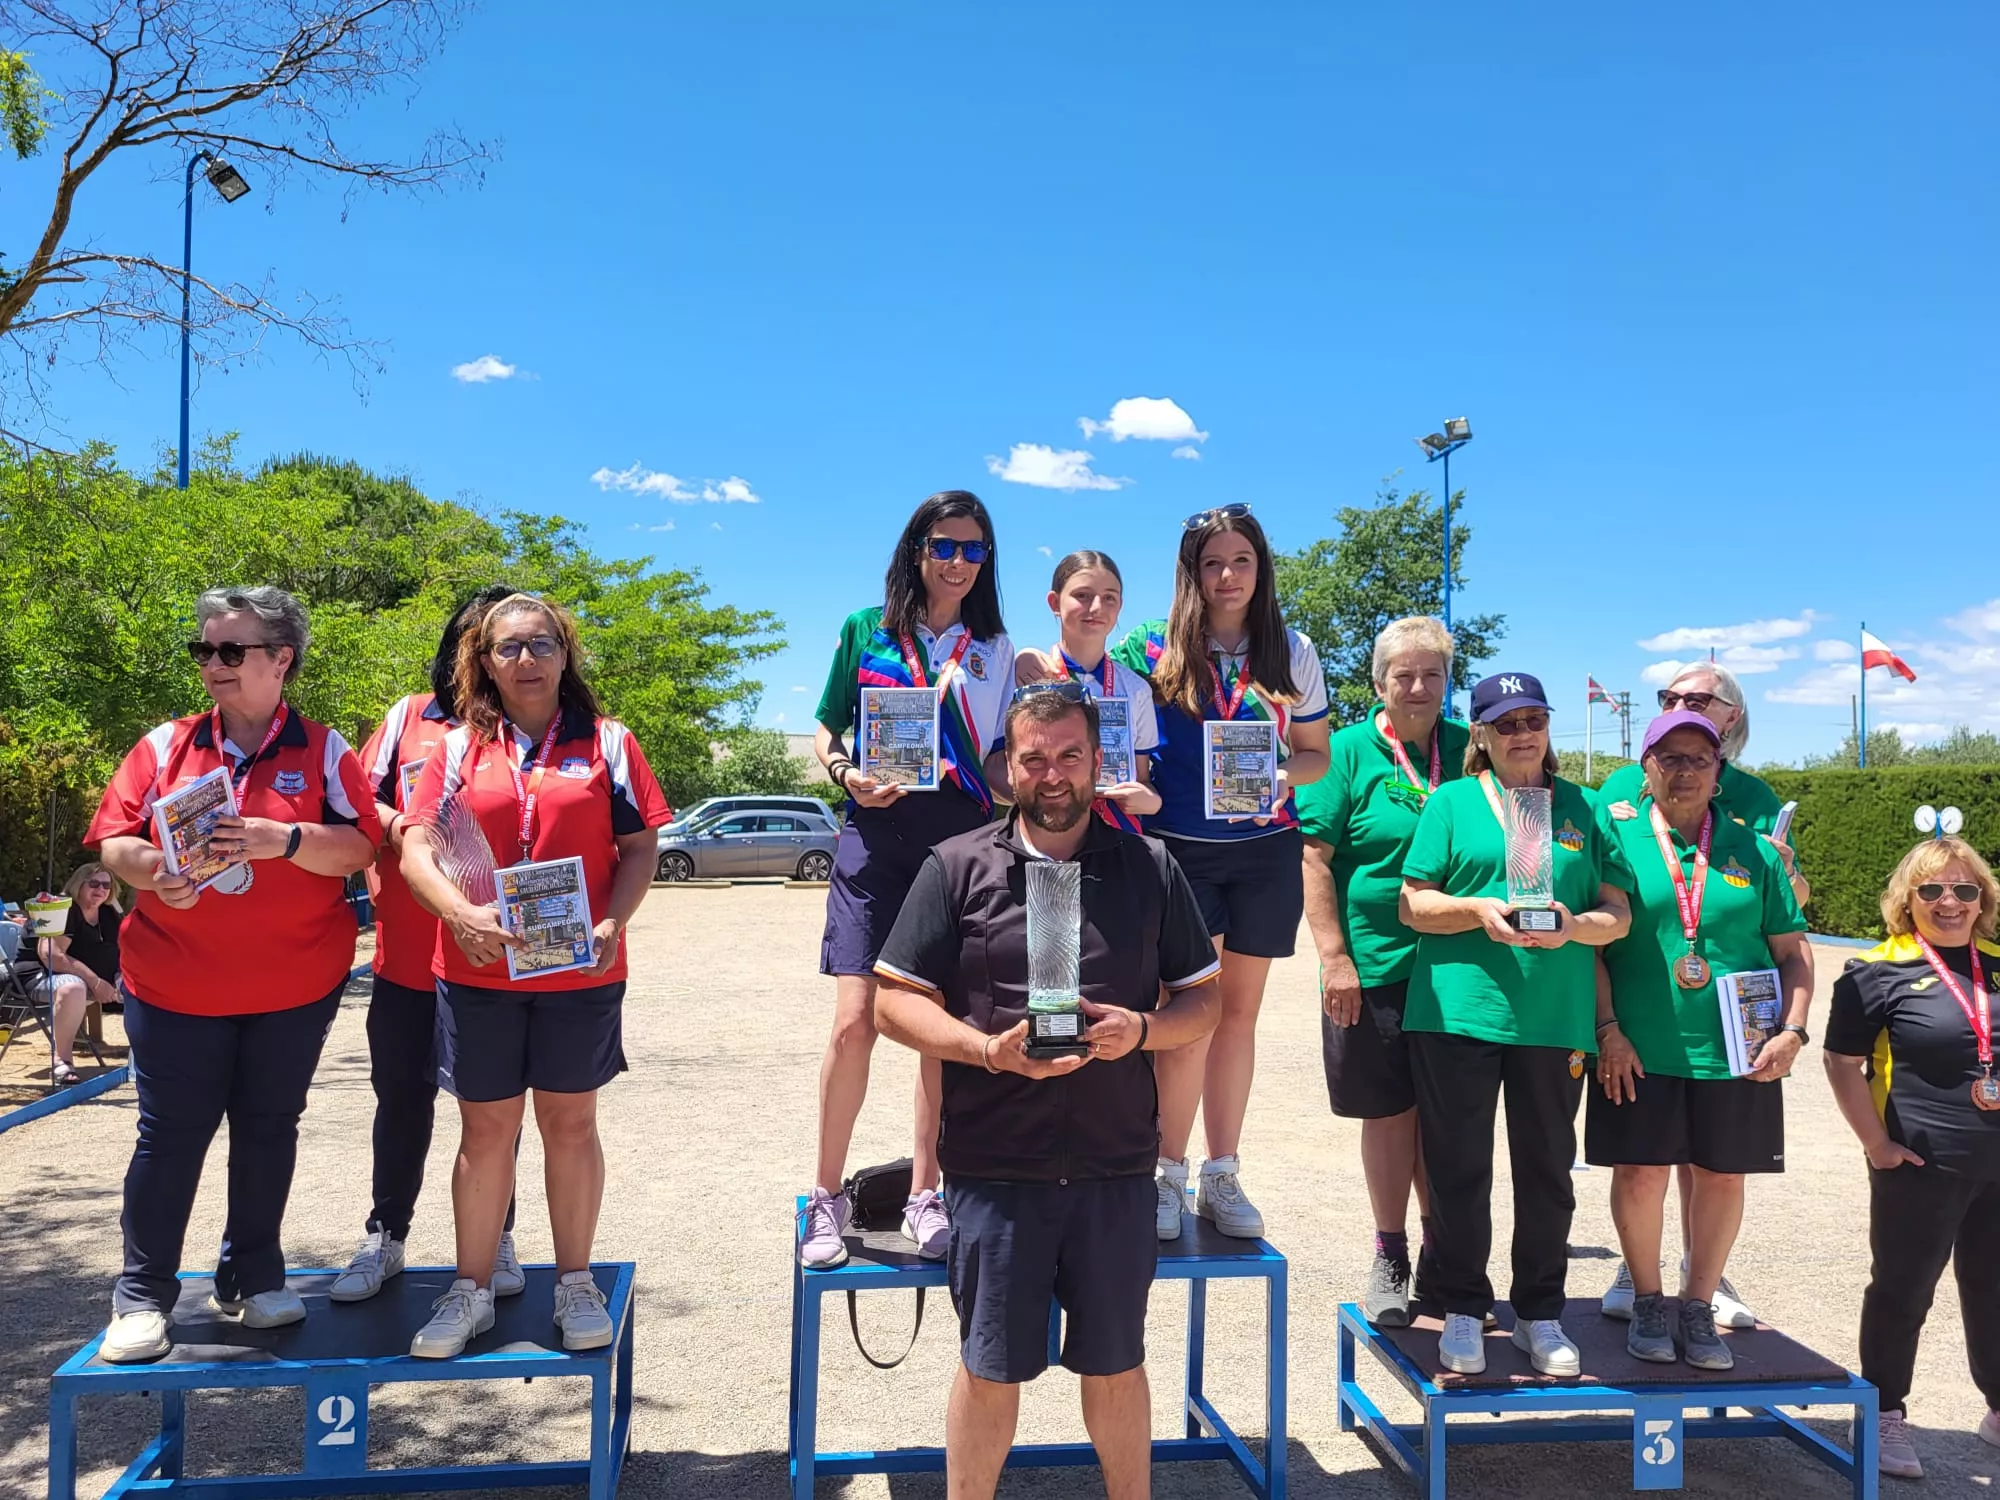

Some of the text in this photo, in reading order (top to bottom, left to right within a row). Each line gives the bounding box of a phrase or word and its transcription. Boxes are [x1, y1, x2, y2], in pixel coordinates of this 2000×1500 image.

[1499, 675, 1524, 694] NY
[527, 918, 582, 932] SUBCAMPEONA
[317, 1395, 356, 1446] 2
[1642, 1420, 1675, 1465] 3
